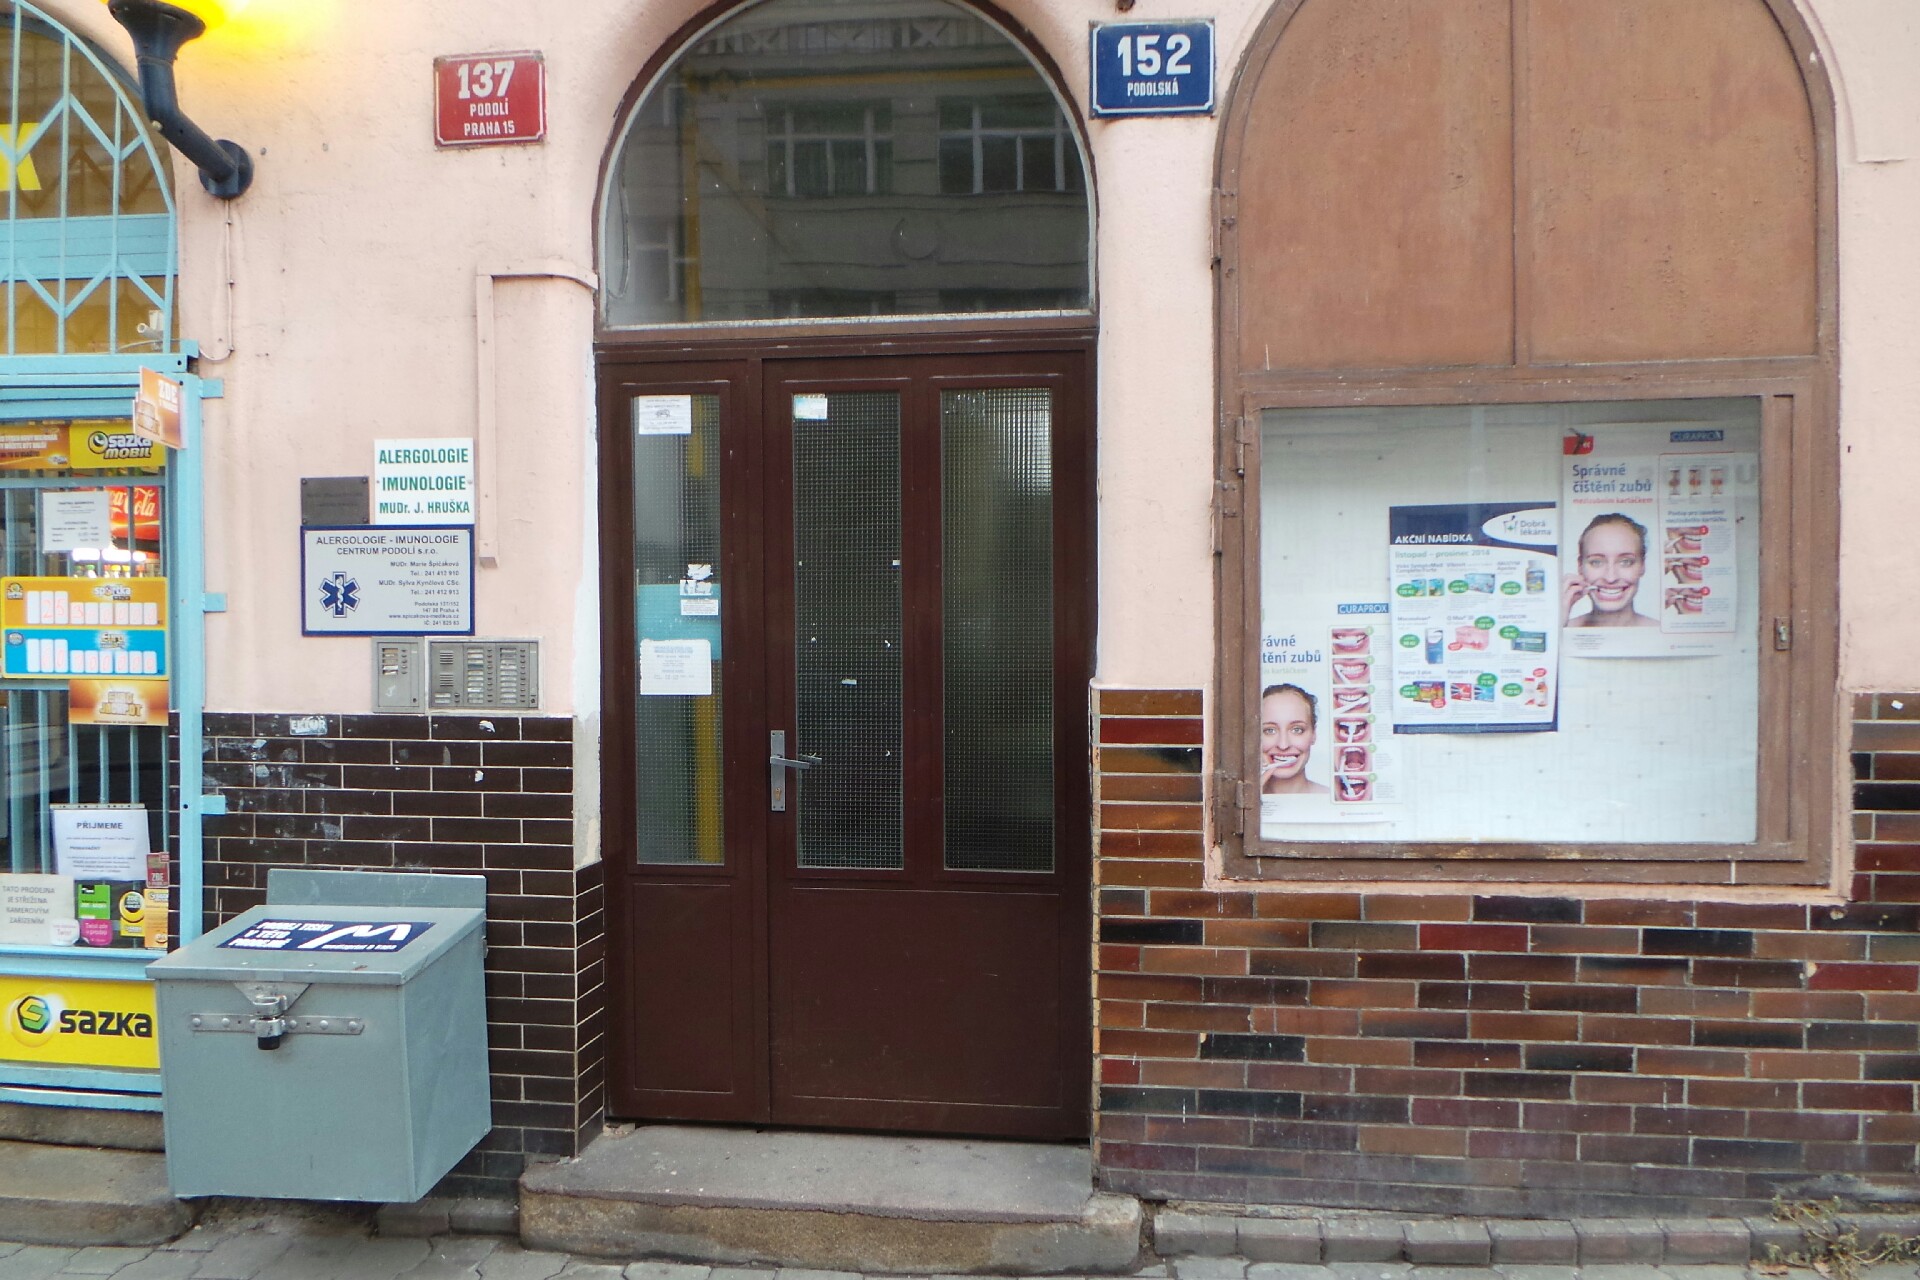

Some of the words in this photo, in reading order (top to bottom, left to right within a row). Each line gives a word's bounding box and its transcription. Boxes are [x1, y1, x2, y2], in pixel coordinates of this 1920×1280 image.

[1117, 34, 1191, 76] 152
[457, 60, 515, 99] 137
[1127, 77, 1179, 97] PODOLSKÁ
[470, 98, 509, 117] PODOLÍ
[464, 121, 501, 136] PRAHA
[503, 120, 516, 134] 15
[379, 448, 469, 464] ALERGOLOGIE
[1572, 462, 1627, 479] Správné
[382, 475, 466, 491] IMUNOLOGIE
[1572, 479, 1616, 493] čištění
[1619, 477, 1653, 493] zubů
[379, 502, 411, 514] MUDr.
[414, 502, 424, 514] J.
[427, 498, 470, 514] HRUŠKA
[1520, 520, 1546, 528] Dobrá
[316, 535, 386, 545] ALERGOLOGIE
[395, 534, 459, 544] IMUNOLOGIE
[1395, 533, 1426, 544] AKČNÍ
[1427, 532, 1474, 544] NABÍDKA
[336, 547, 379, 555] CENTRUM
[381, 546, 416, 555] PODOLÍ
[1395, 551, 1427, 559] listopad
[428, 560, 460, 569] Špičáková
[398, 580, 416, 588] Sylva
[1339, 604, 1388, 614] CURAPROX
[1290, 649, 1322, 663] zubů
[76, 820, 123, 830] PŘIJMEME
[2, 885, 19, 894] TATO
[21, 886, 55, 894] PRODEJNA
[15, 895, 48, 904] STŘEŽENA
[6, 906, 49, 915] KAMEROVÝM
[59, 1009, 153, 1038] sazka
